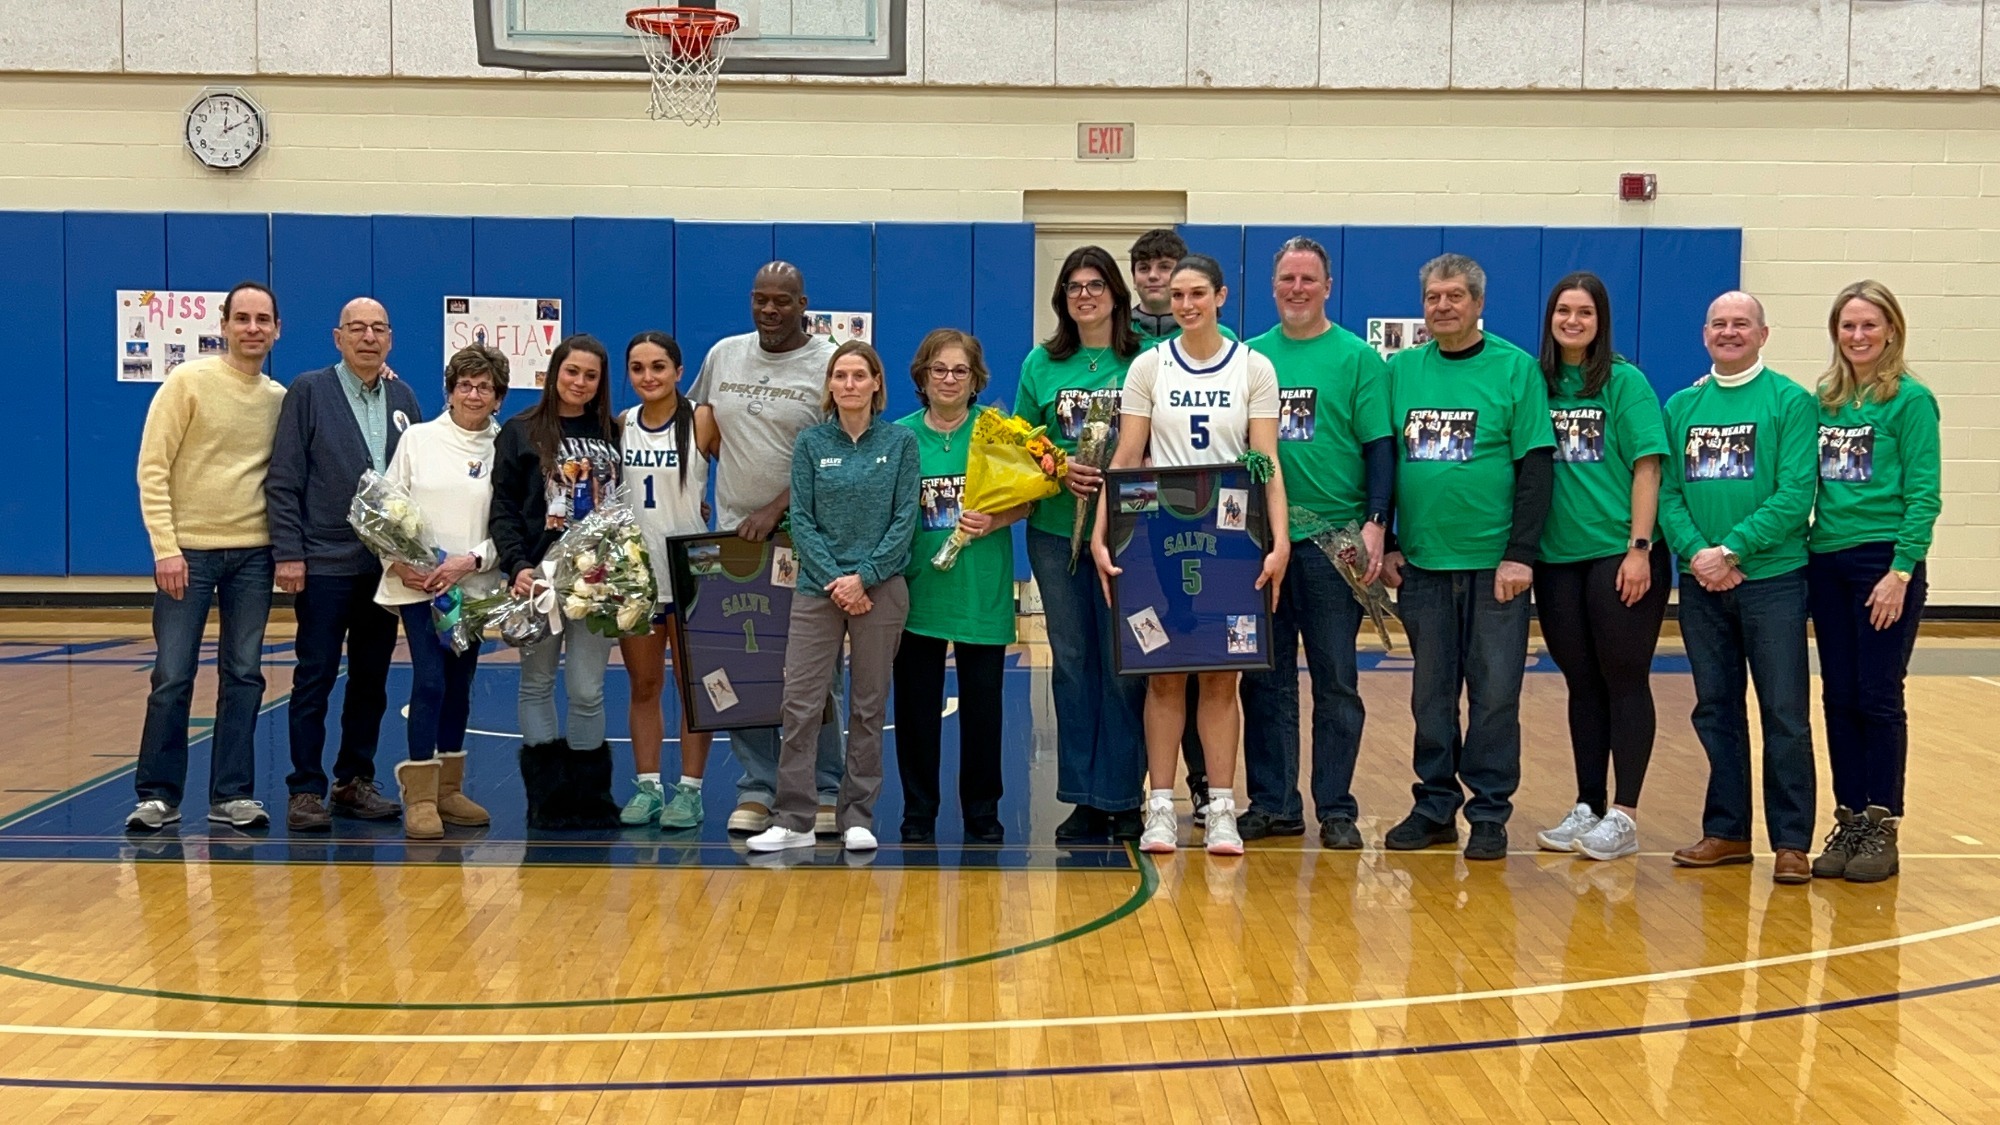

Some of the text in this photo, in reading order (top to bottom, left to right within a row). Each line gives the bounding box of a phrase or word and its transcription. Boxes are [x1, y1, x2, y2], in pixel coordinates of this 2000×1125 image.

[244, 114, 251, 124] 2
[195, 126, 202, 135] 9
[247, 127, 254, 137] 3
[200, 139, 207, 149] 8
[244, 141, 251, 149] 4
[1088, 127, 1124, 154] EXIT
[209, 147, 216, 155] 7
[222, 152, 229, 162] 6
[234, 149, 241, 159] 5
[452, 322, 555, 357] SOFIA!
[719, 382, 807, 402] BASKETBALL
[1280, 389, 1313, 399] NEARY
[1170, 390, 1231, 408] SALVE
[1440, 411, 1475, 421] NEARY
[1568, 409, 1602, 420] NEARY
[1190, 415, 1210, 450] 5
[1721, 425, 1754, 437] NEARY
[624, 449, 678, 468] SALVE
[643, 475, 656, 509] 1
[1163, 531, 1218, 556] SALVE
[1181, 558, 1203, 595] 5
[721, 593, 771, 618] SALVE
[742, 618, 759, 653] 1
